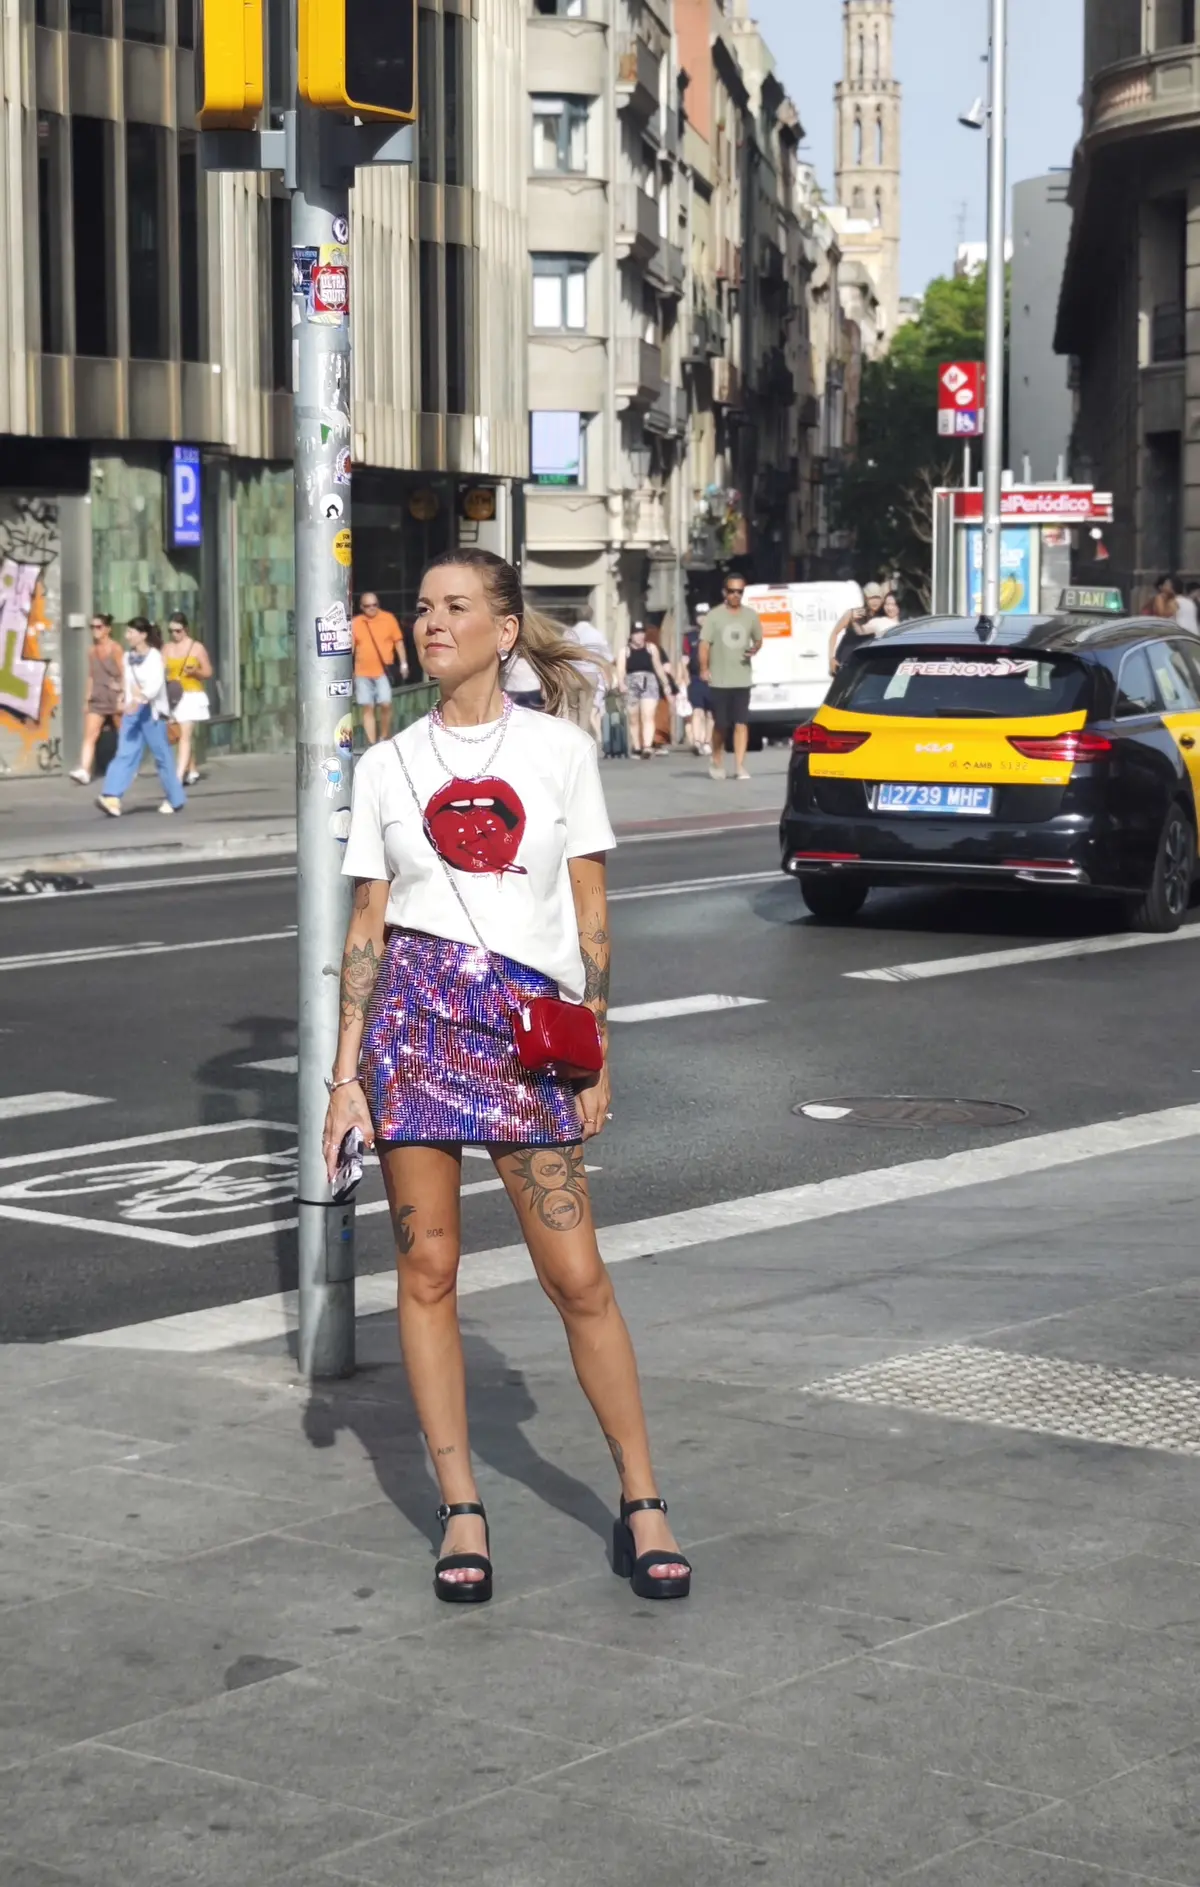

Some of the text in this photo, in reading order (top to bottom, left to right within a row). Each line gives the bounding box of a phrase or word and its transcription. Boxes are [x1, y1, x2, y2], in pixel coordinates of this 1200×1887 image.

[321, 274, 346, 289] ULTRA
[321, 289, 346, 302] SOUTH
[175, 465, 196, 527] P
[1078, 591, 1106, 607] TAXI
[899, 662, 1001, 676] FREENOW
[890, 785, 986, 807] 2739 MHF
